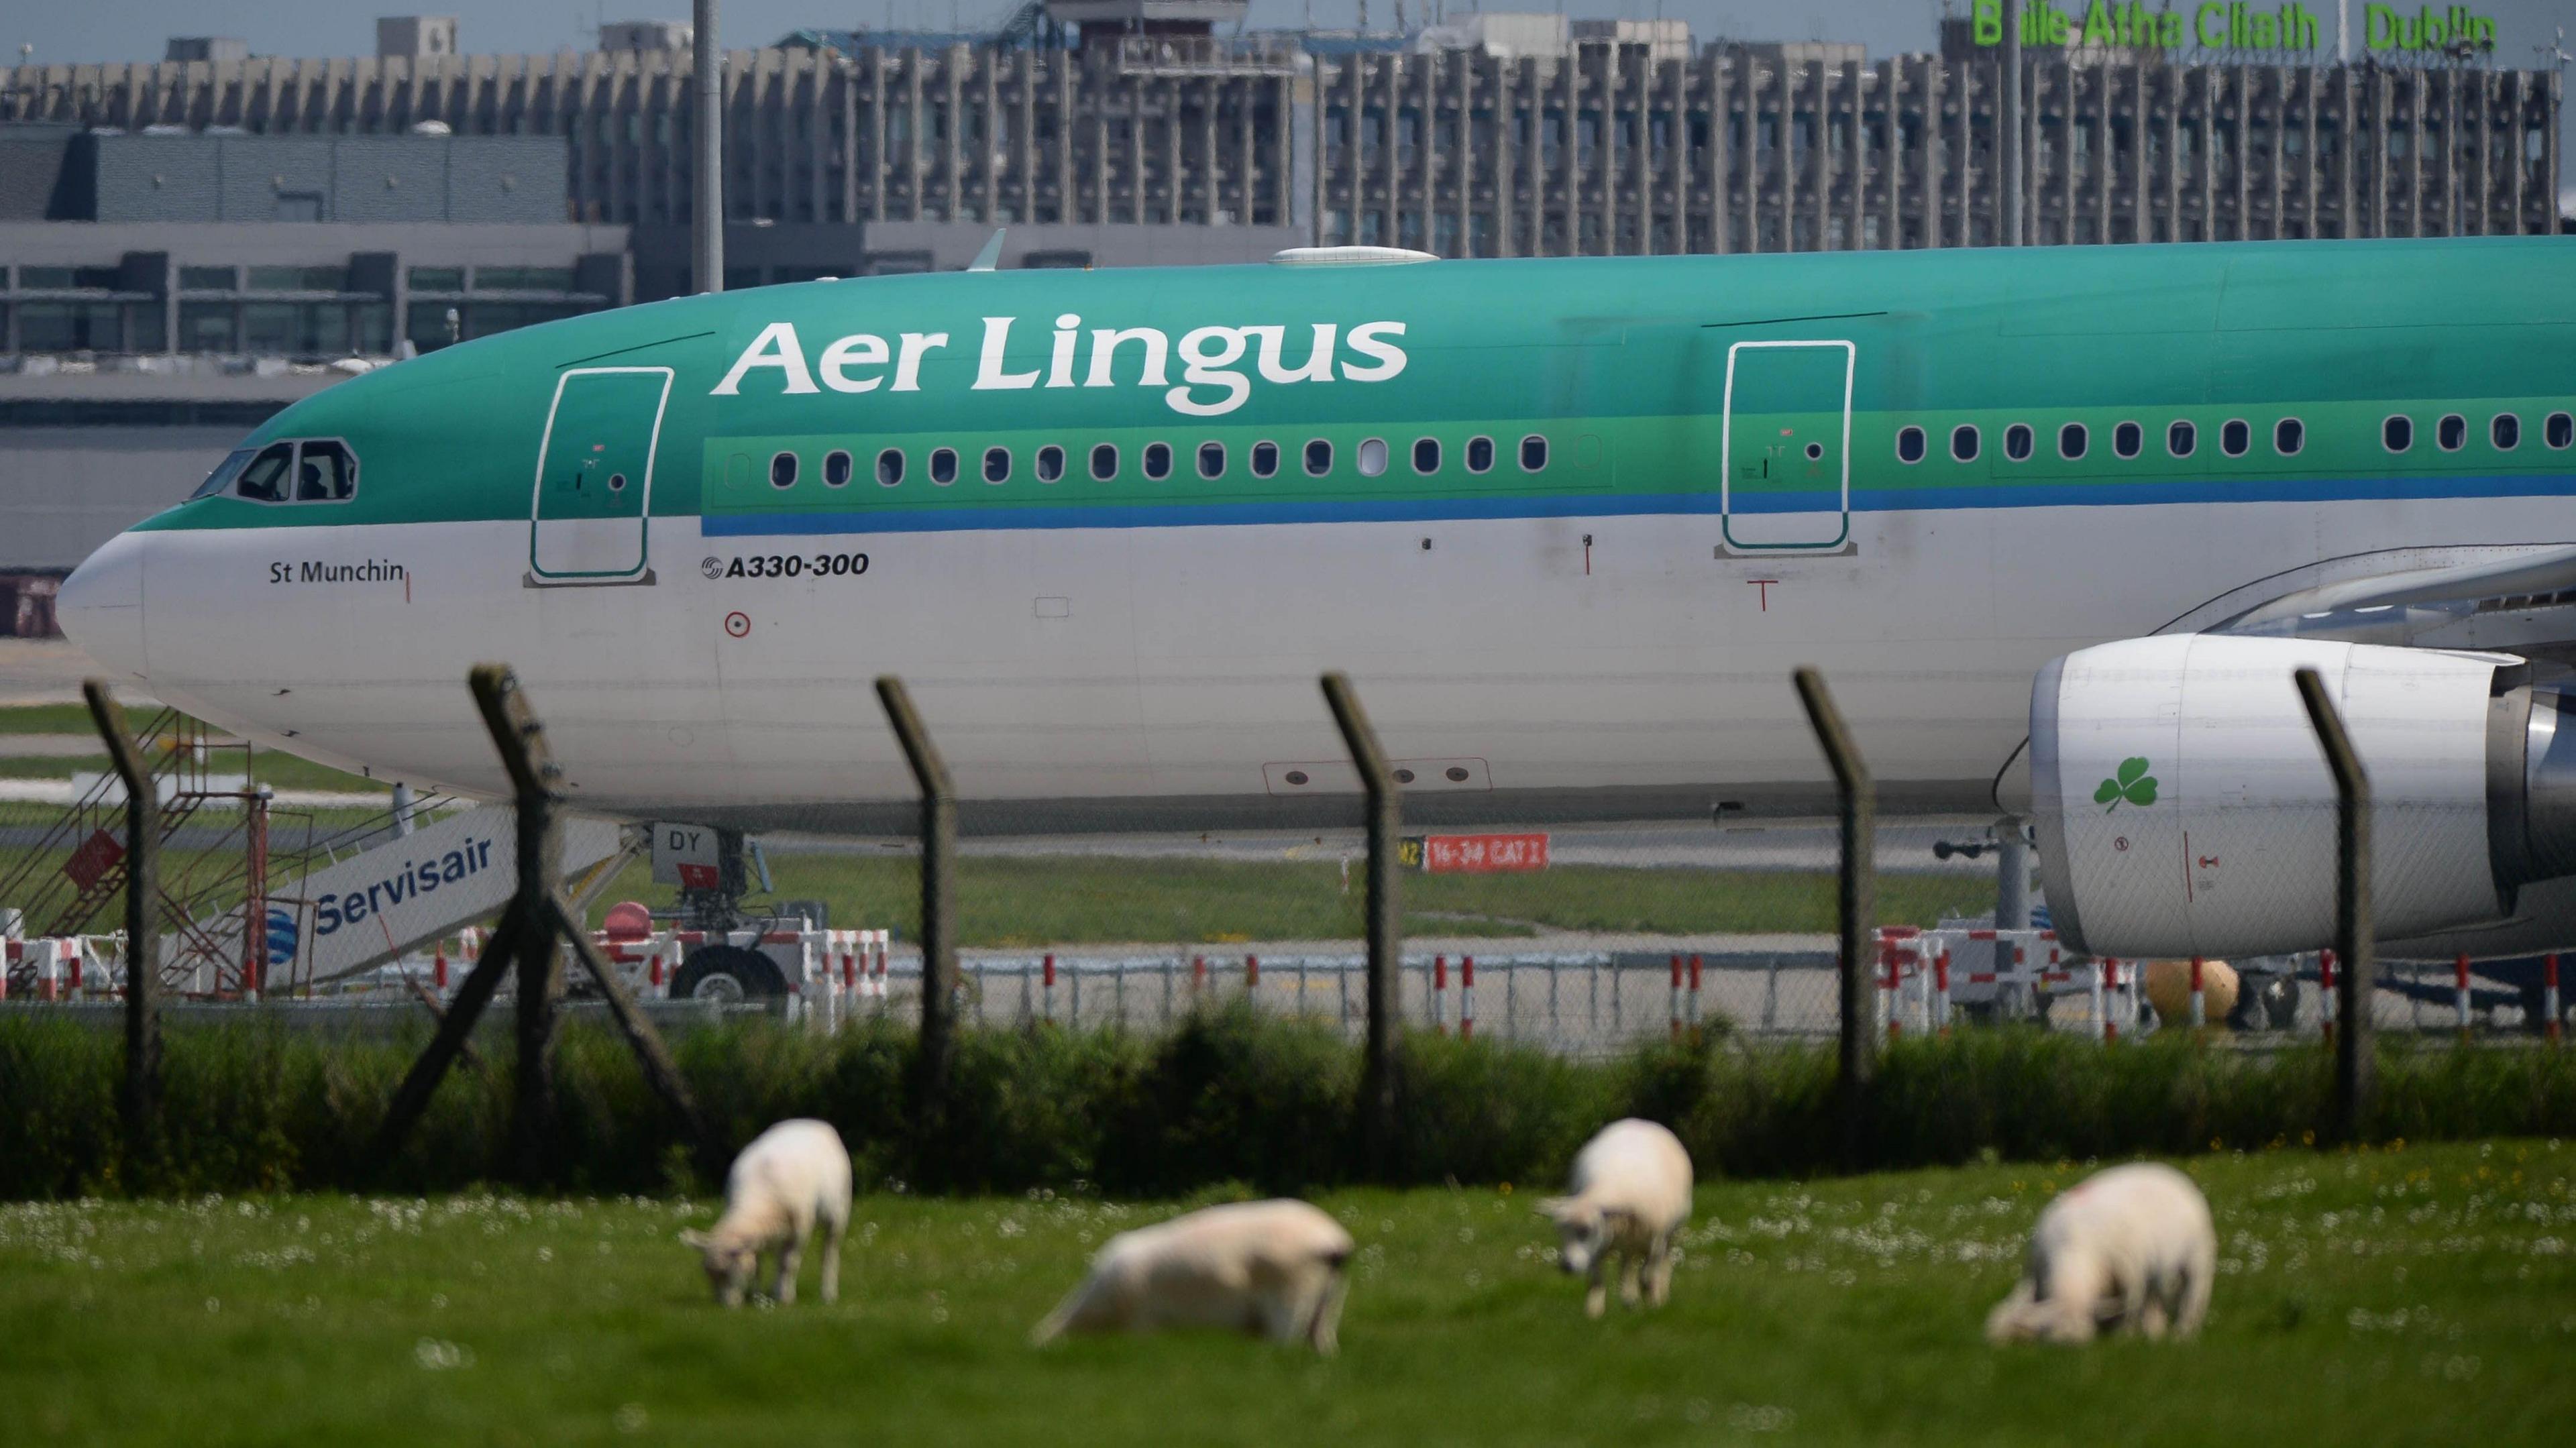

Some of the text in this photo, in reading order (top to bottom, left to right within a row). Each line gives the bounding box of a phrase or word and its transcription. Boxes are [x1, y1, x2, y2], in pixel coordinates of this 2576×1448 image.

[2197, 0, 2318, 49] Cliath
[2367, 4, 2496, 50] Dublin
[710, 313, 1407, 416] Aer Lingus
[270, 559, 403, 583] St Munchin
[725, 553, 869, 578] A330-300
[669, 831, 700, 852] DY
[1491, 841, 1525, 864] CAT
[316, 837, 491, 936] Servisair
